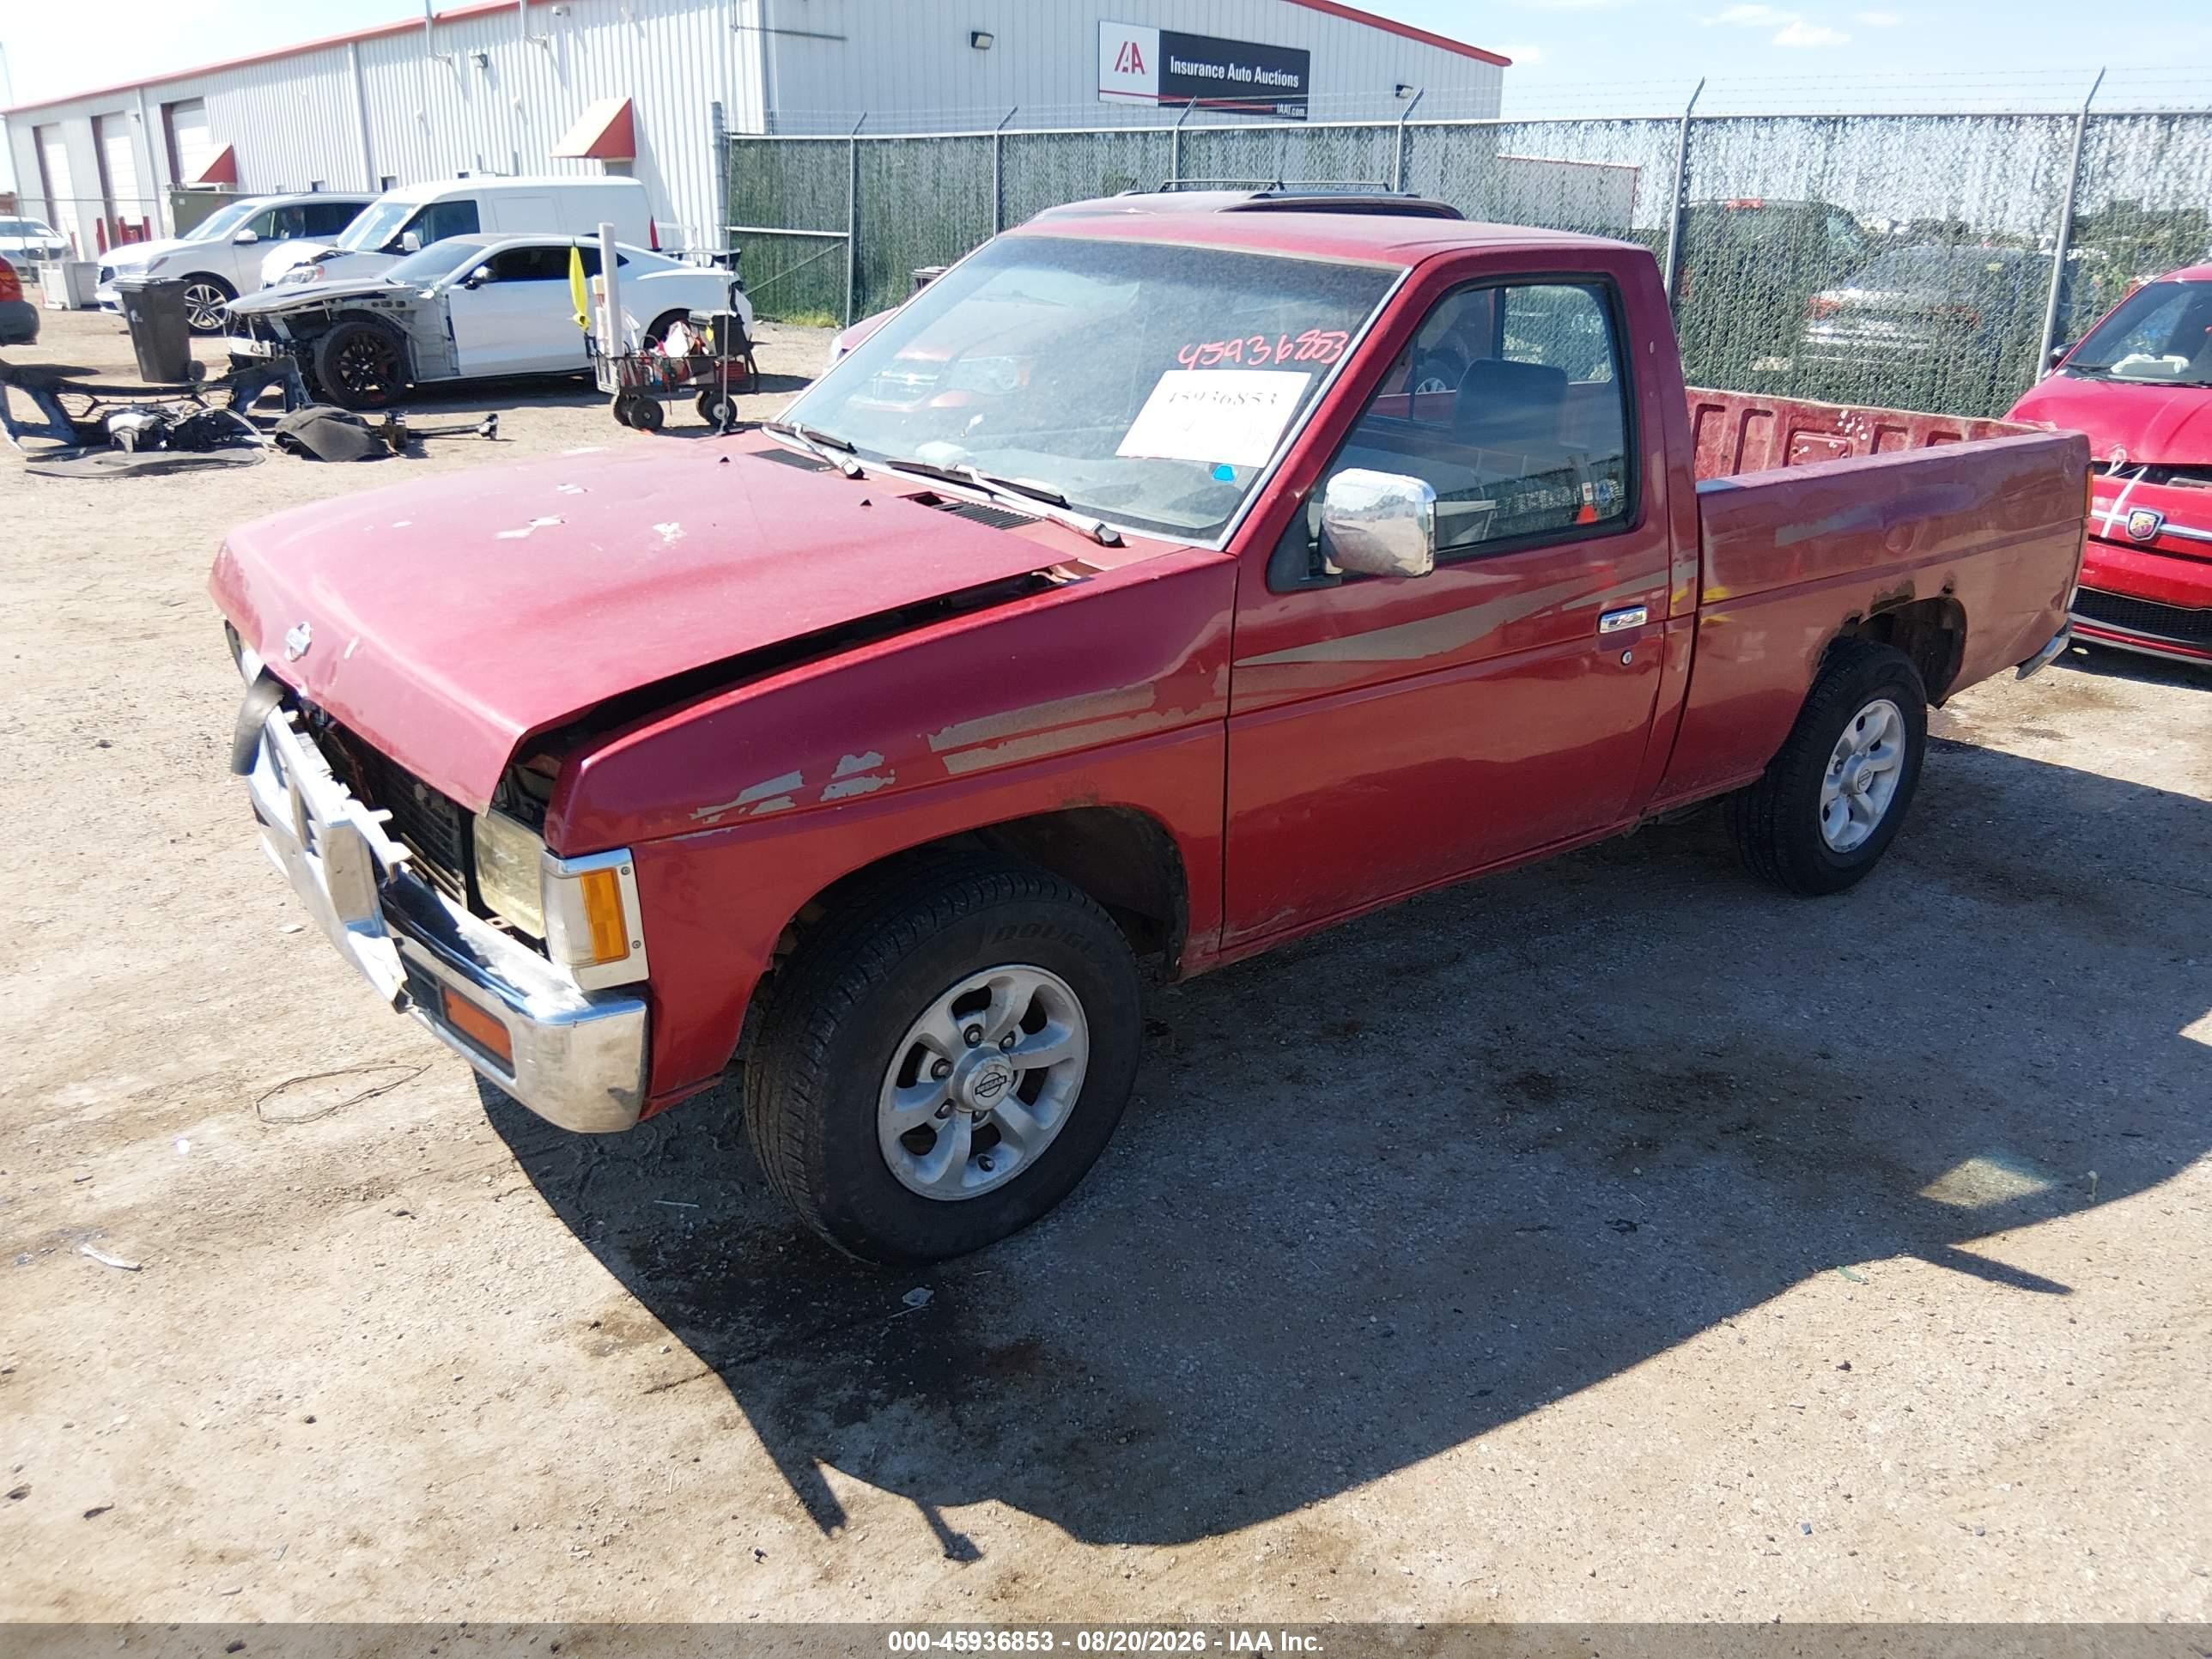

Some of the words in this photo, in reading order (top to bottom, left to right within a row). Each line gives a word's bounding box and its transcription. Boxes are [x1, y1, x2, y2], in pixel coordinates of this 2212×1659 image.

[1170, 55, 1225, 80] Insurance
[1227, 63, 1252, 82] Auto
[1254, 66, 1299, 88] Auctions
[1177, 329, 1349, 371] 45936853
